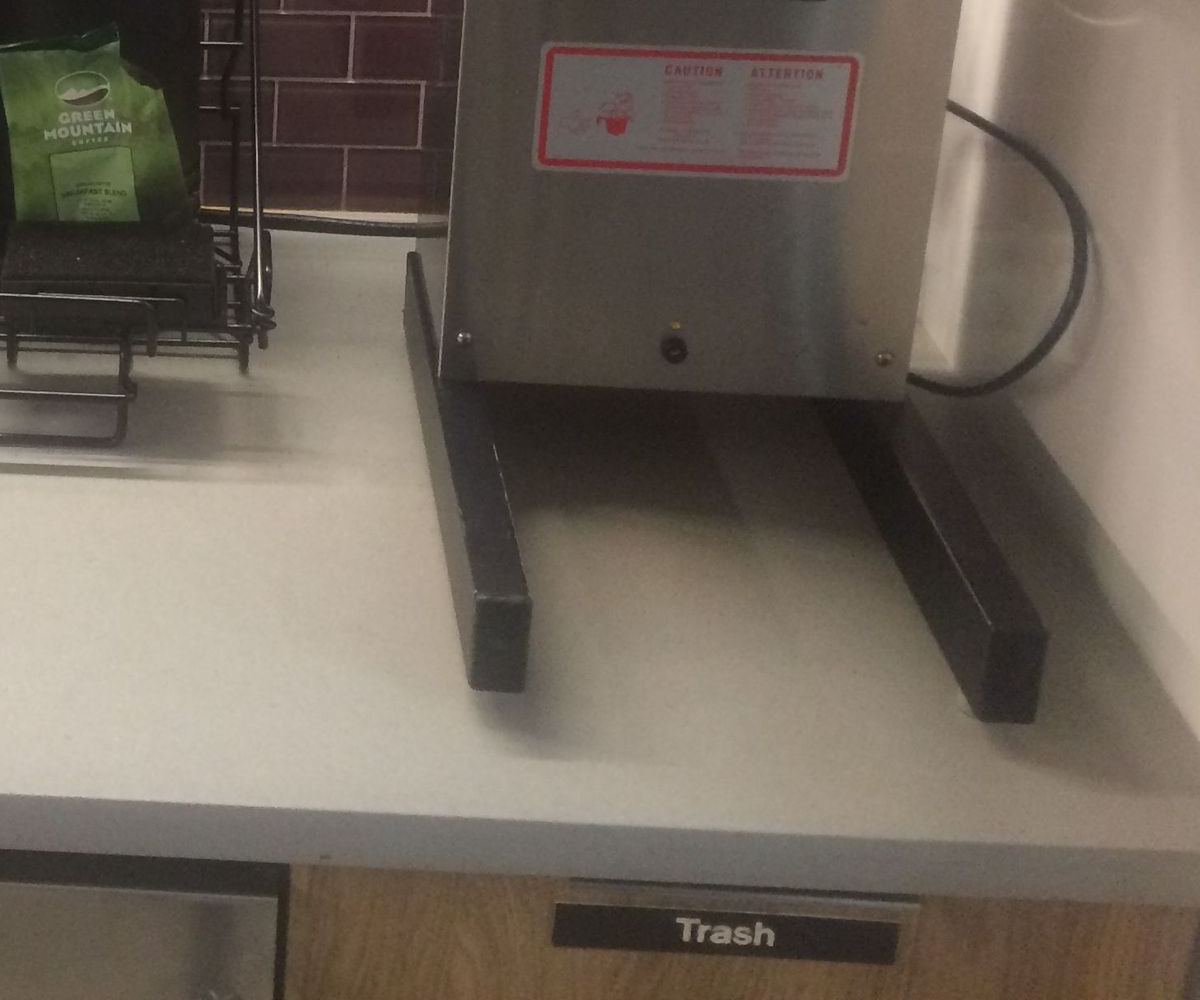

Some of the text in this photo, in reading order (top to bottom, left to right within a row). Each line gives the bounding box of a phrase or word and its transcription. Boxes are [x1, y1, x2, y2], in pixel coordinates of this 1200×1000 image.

[664, 64, 723, 78] CAUTION
[751, 67, 824, 80] ATTENTION
[58, 109, 116, 124] GREEN
[43, 121, 132, 141] MOUNTAIN
[675, 917, 776, 947] Trash
